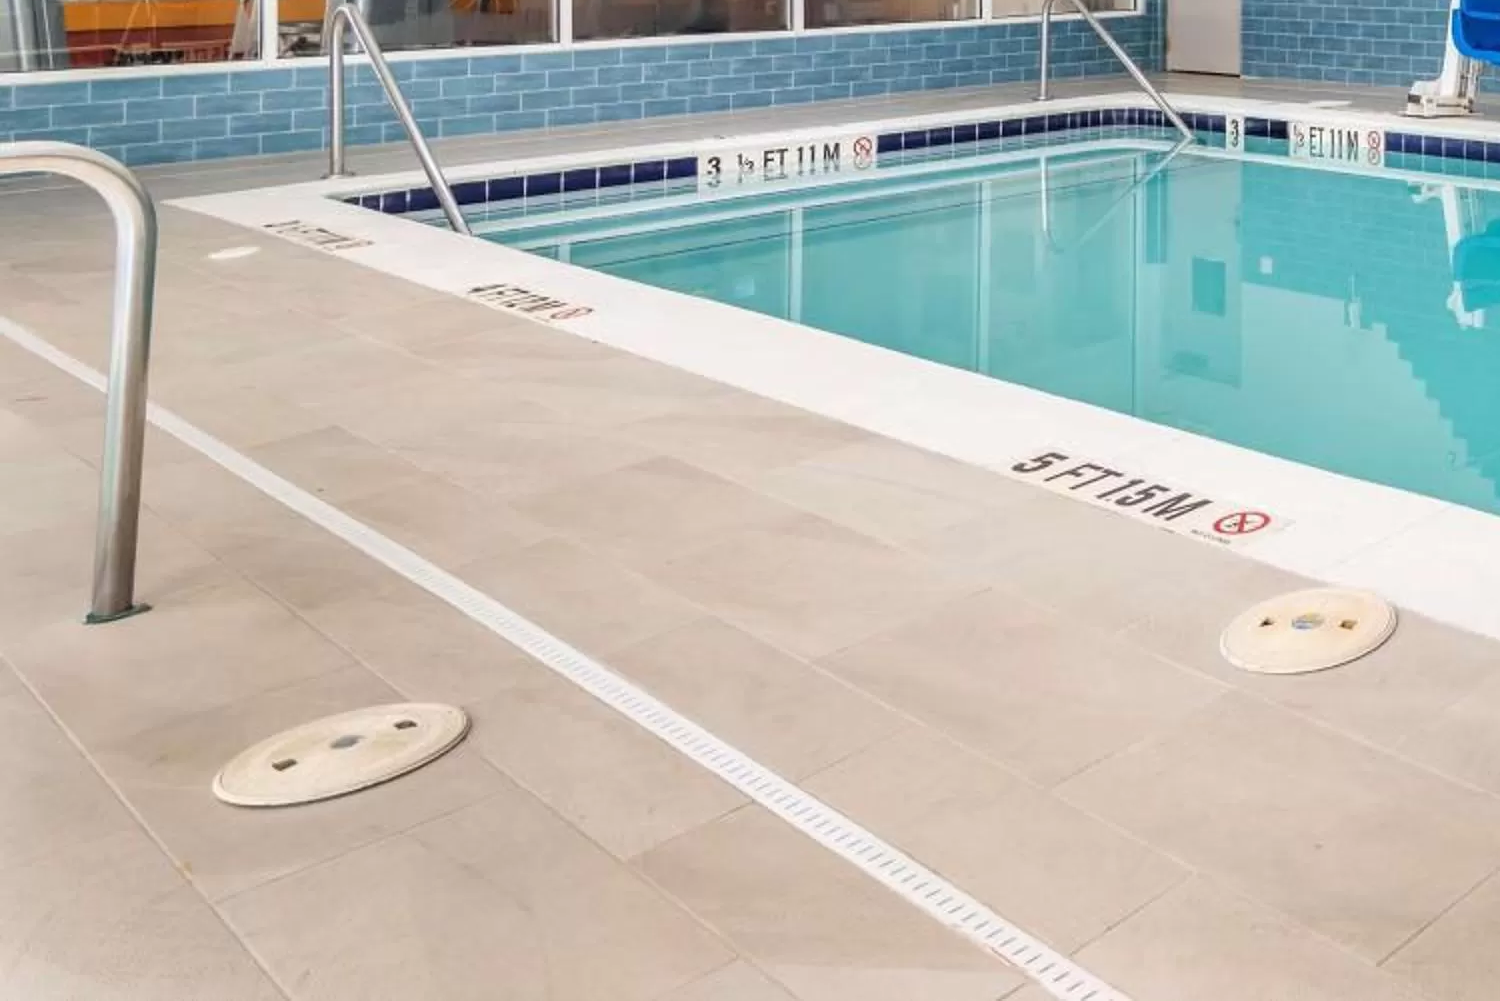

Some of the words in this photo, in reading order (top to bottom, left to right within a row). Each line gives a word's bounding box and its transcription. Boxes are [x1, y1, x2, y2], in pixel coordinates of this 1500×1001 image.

[707, 156, 721, 175] 3
[763, 148, 789, 169] FT
[1011, 452, 1070, 474] 5
[1043, 462, 1124, 490] FT
